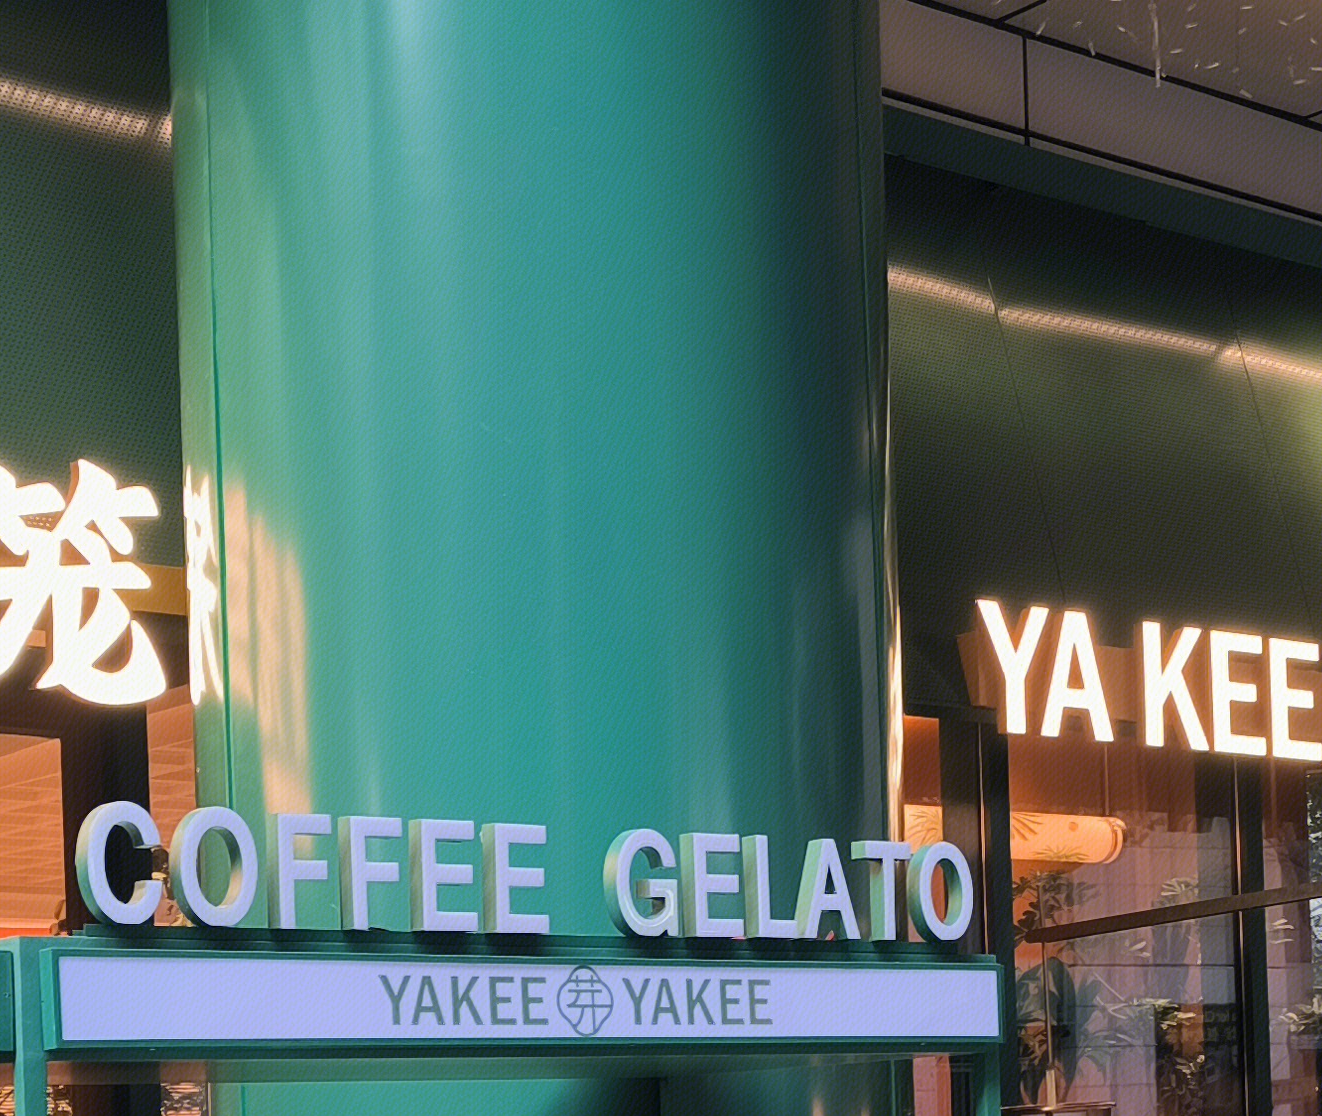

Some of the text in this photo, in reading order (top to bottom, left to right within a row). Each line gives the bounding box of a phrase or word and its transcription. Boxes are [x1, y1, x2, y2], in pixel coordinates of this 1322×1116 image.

[976, 598, 1114, 742] YA
[75, 801, 974, 942] COFFEE GELATO
[379, 975, 549, 1026] YAKEE
[622, 978, 773, 1026] YAKEE
